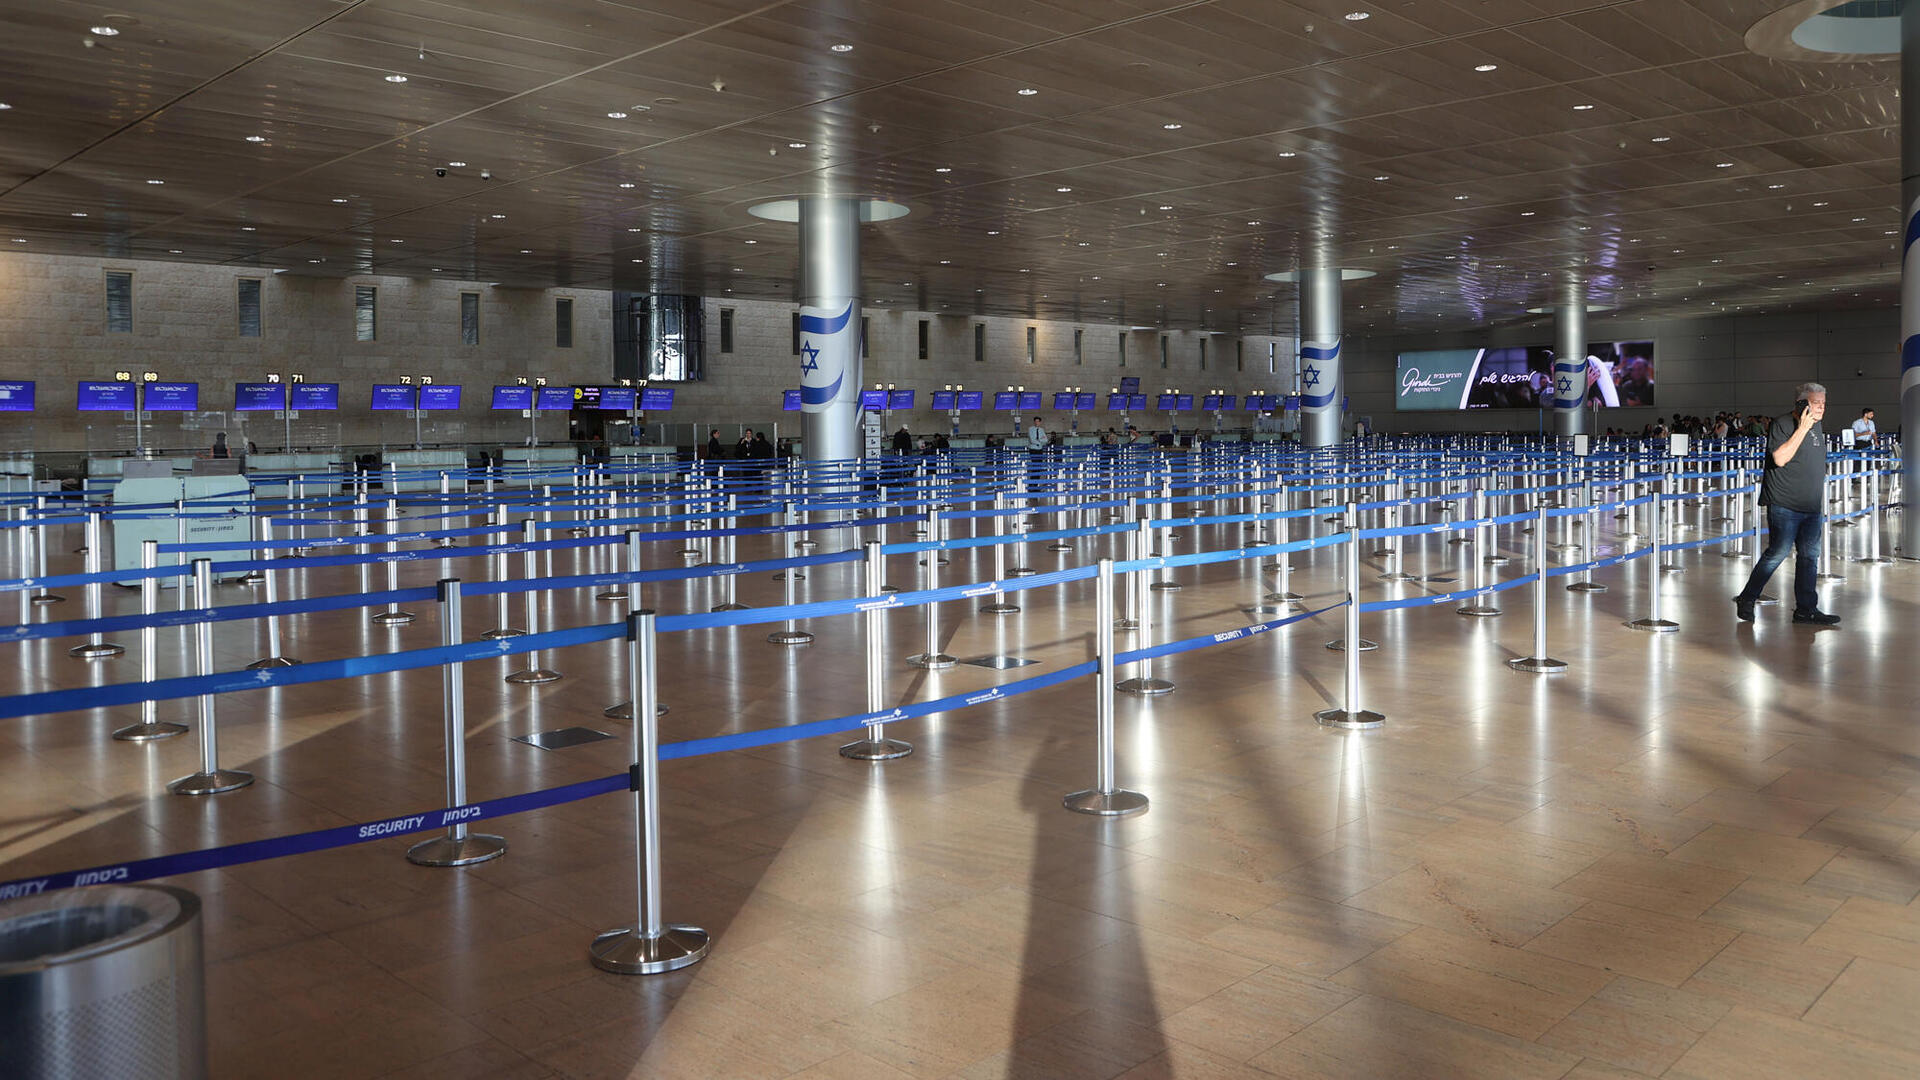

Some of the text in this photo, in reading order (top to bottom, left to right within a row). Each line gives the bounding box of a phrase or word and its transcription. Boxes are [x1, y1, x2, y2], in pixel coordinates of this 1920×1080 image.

[115, 372, 130, 381] 68
[143, 372, 158, 381] 69
[267, 374, 280, 383] 70
[292, 374, 303, 383] 71
[400, 376, 411, 384] 72
[421, 376, 432, 384] 73
[517, 377, 527, 385] 74
[1479, 371, 1536, 385] להרגיש שלם
[536, 378, 546, 386] 75
[1214, 629, 1243, 642] SECURITY
[442, 806, 481, 825] ביטחון
[359, 816, 424, 838] SECURITY
[74, 867, 128, 888] ביטחון
